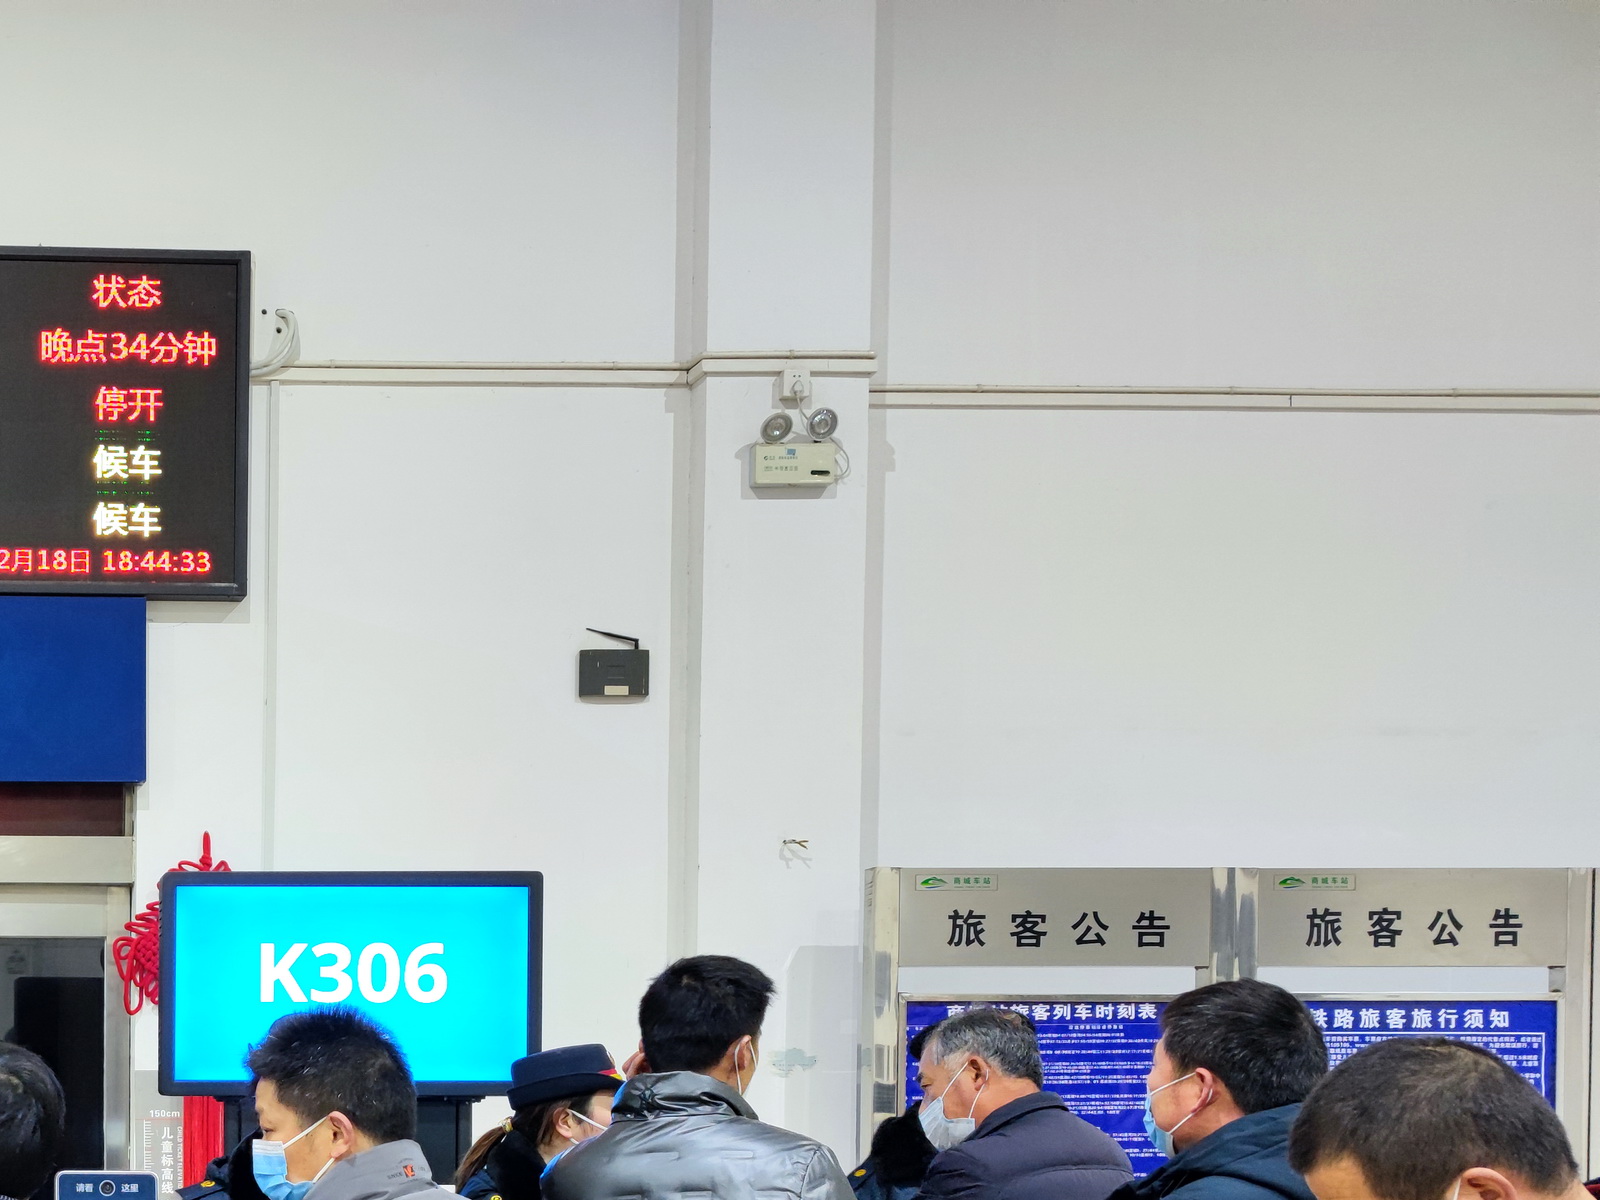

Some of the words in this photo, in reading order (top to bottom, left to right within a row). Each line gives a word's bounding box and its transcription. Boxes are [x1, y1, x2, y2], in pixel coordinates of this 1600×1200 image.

[91, 274, 163, 309] 状态
[40, 330, 218, 367] 晚点34分钟
[94, 387, 164, 422] 停开
[92, 444, 163, 481] 候车
[92, 501, 163, 538] 候车
[103, 549, 212, 574] 18:44:33
[947, 909, 1171, 948] 旅客公告
[1305, 907, 1523, 948] 旅客公告
[258, 941, 449, 1004] K306
[946, 1003, 1157, 1021] 商旅客列车时刻表
[149, 1109, 180, 1118] 150cm
[161, 1126, 174, 1194] 儿童标高线
[75, 1183, 94, 1193] 请看
[121, 1183, 139, 1193] 这里
